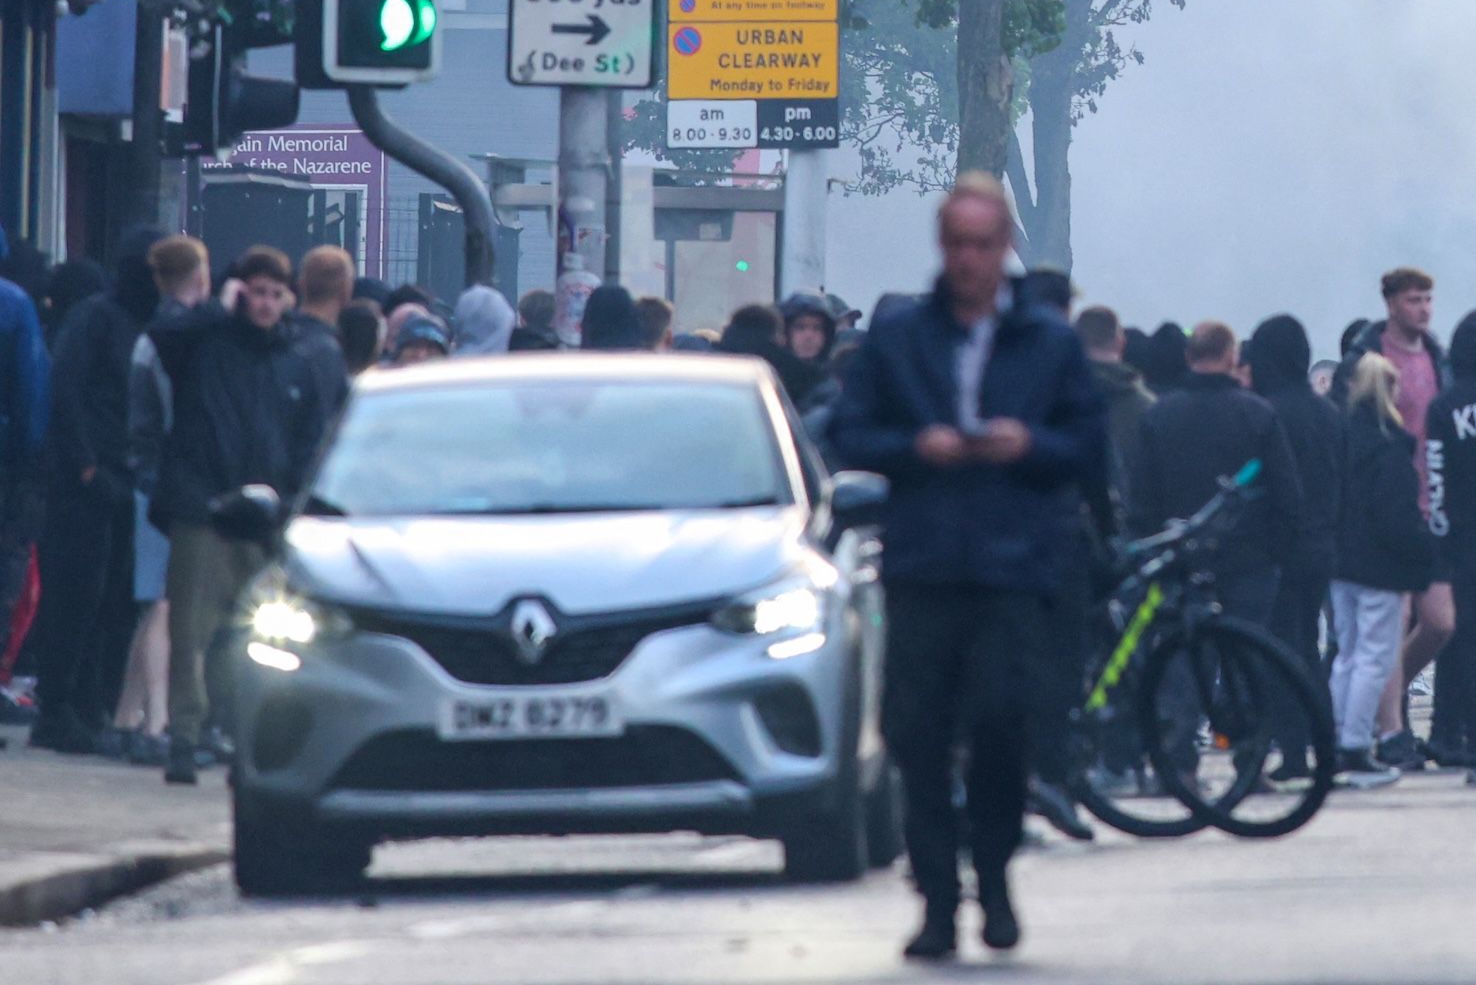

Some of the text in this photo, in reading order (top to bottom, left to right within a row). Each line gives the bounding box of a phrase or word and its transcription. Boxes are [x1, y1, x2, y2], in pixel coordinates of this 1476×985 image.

[736, 30, 804, 45] URBAN
[526, 50, 635, 75] (Dee St)
[718, 53, 822, 68] CLEARWAY
[710, 78, 830, 93] Monday to Friday
[700, 109, 724, 121] am
[785, 107, 812, 122] pm
[232, 135, 348, 156] ain Memorial
[293, 159, 371, 174] Nazarene
